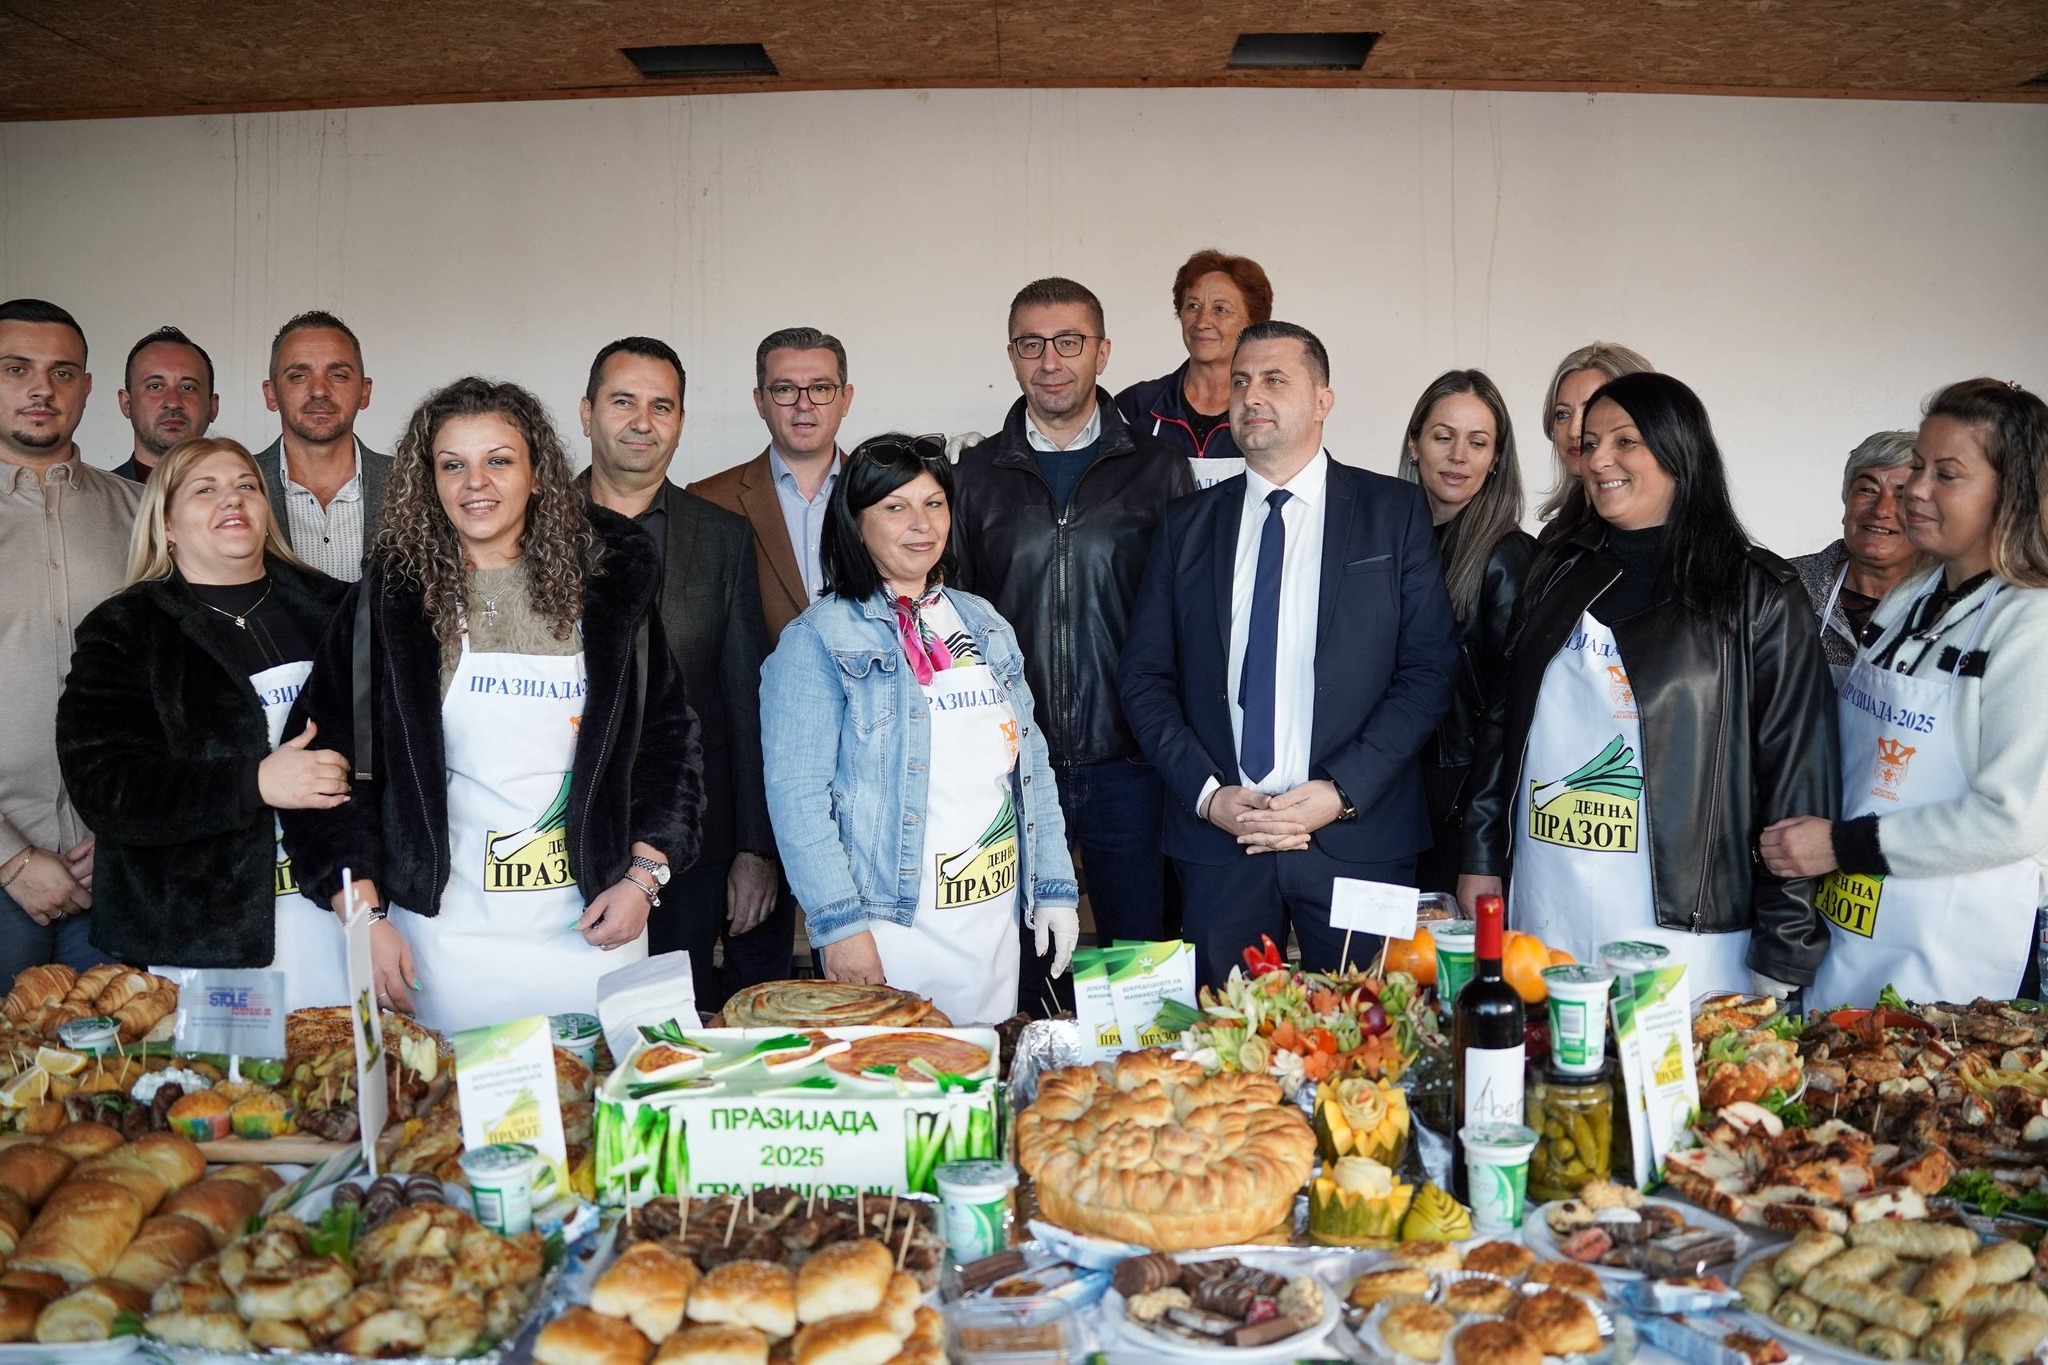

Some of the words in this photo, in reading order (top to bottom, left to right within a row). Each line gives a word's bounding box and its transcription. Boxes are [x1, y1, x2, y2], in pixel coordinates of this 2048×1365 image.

[1573, 799, 1605, 816] ДЕН
[1608, 804, 1633, 819] НА
[1534, 811, 1632, 848] ПРАЗОТ
[987, 849, 1007, 869] ДЕН
[945, 860, 1016, 904] ПРАЗОТ
[1850, 880, 1874, 901] НА
[711, 1108, 878, 1136] ПРАЗИЈАДА
[760, 1146, 824, 1167] 2025
